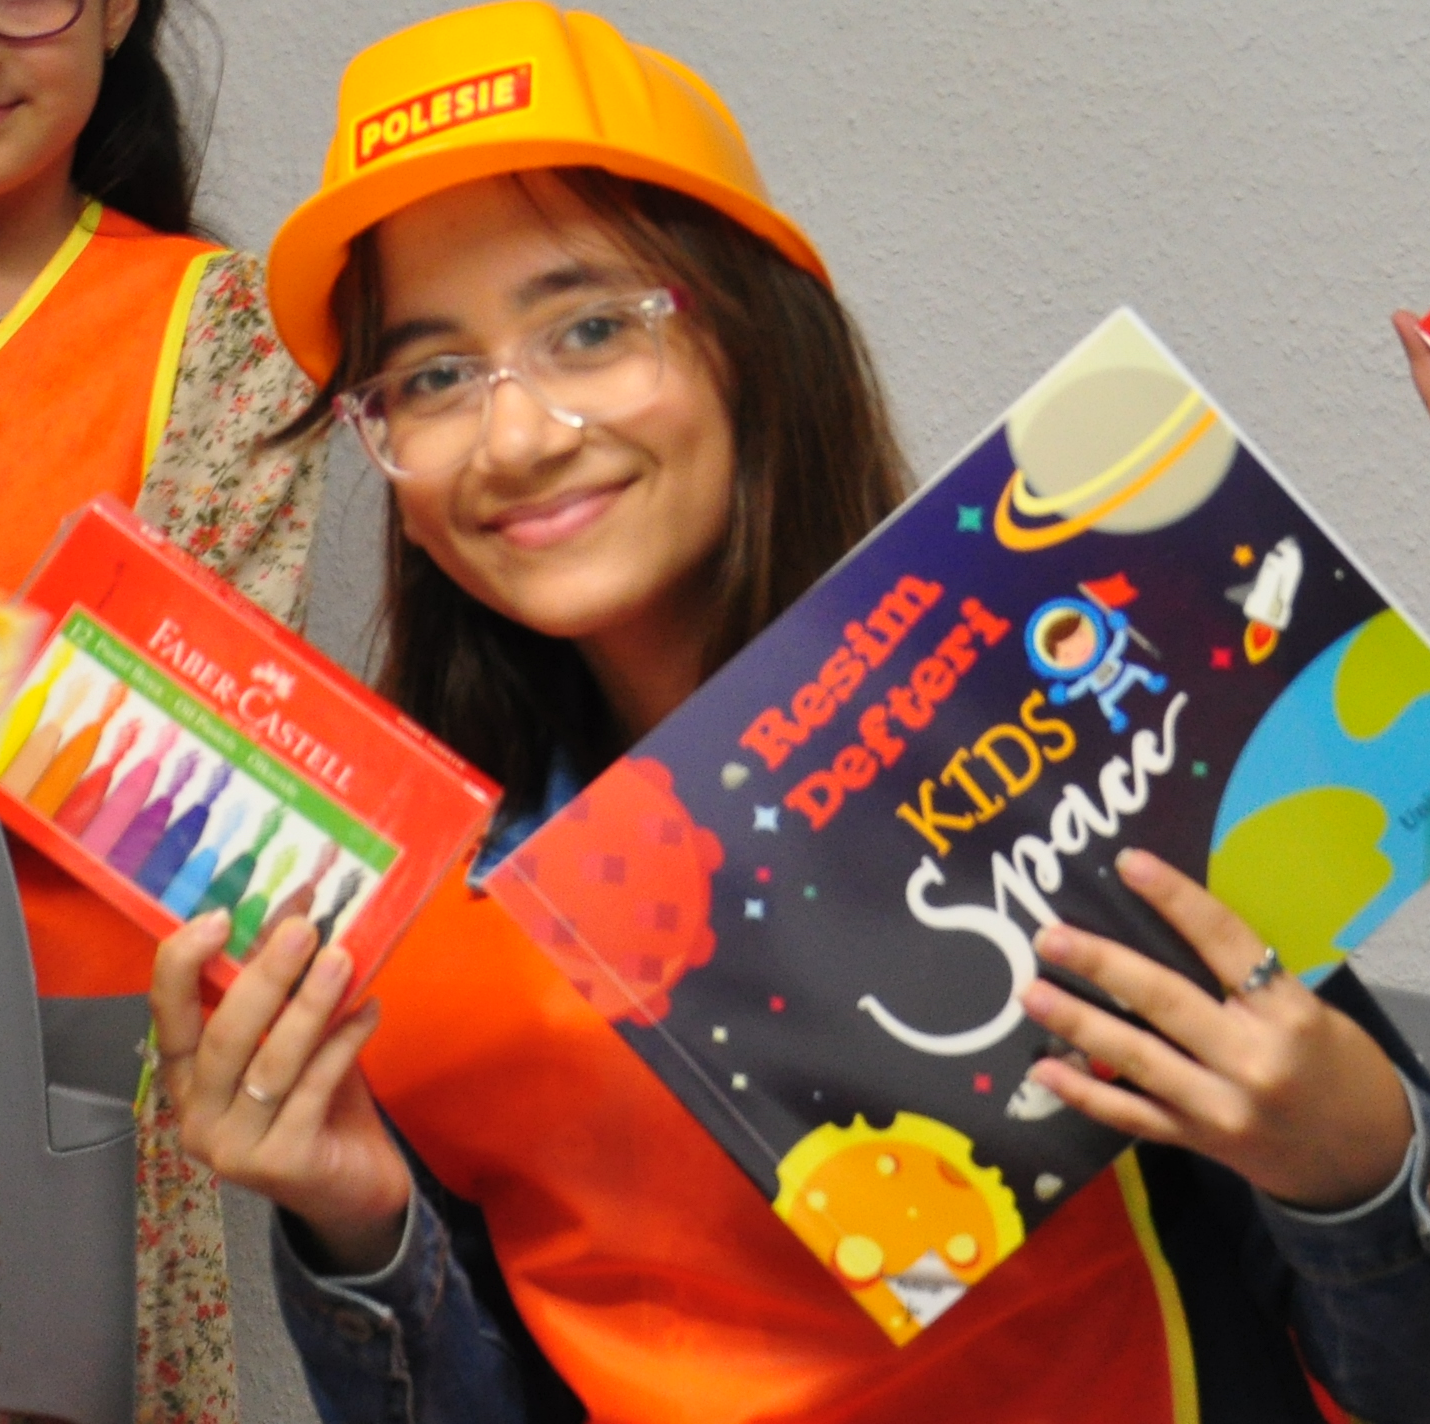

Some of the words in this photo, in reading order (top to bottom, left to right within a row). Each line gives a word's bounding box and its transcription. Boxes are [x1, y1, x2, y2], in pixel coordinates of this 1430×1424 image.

[361, 73, 515, 158] POLESIE
[147, 617, 355, 793] FABER-CASTELL
[739, 574, 944, 771] Resim
[783, 596, 1011, 831] Defteri
[895, 689, 1077, 858] KIDS
[857, 691, 1189, 1056] Space
